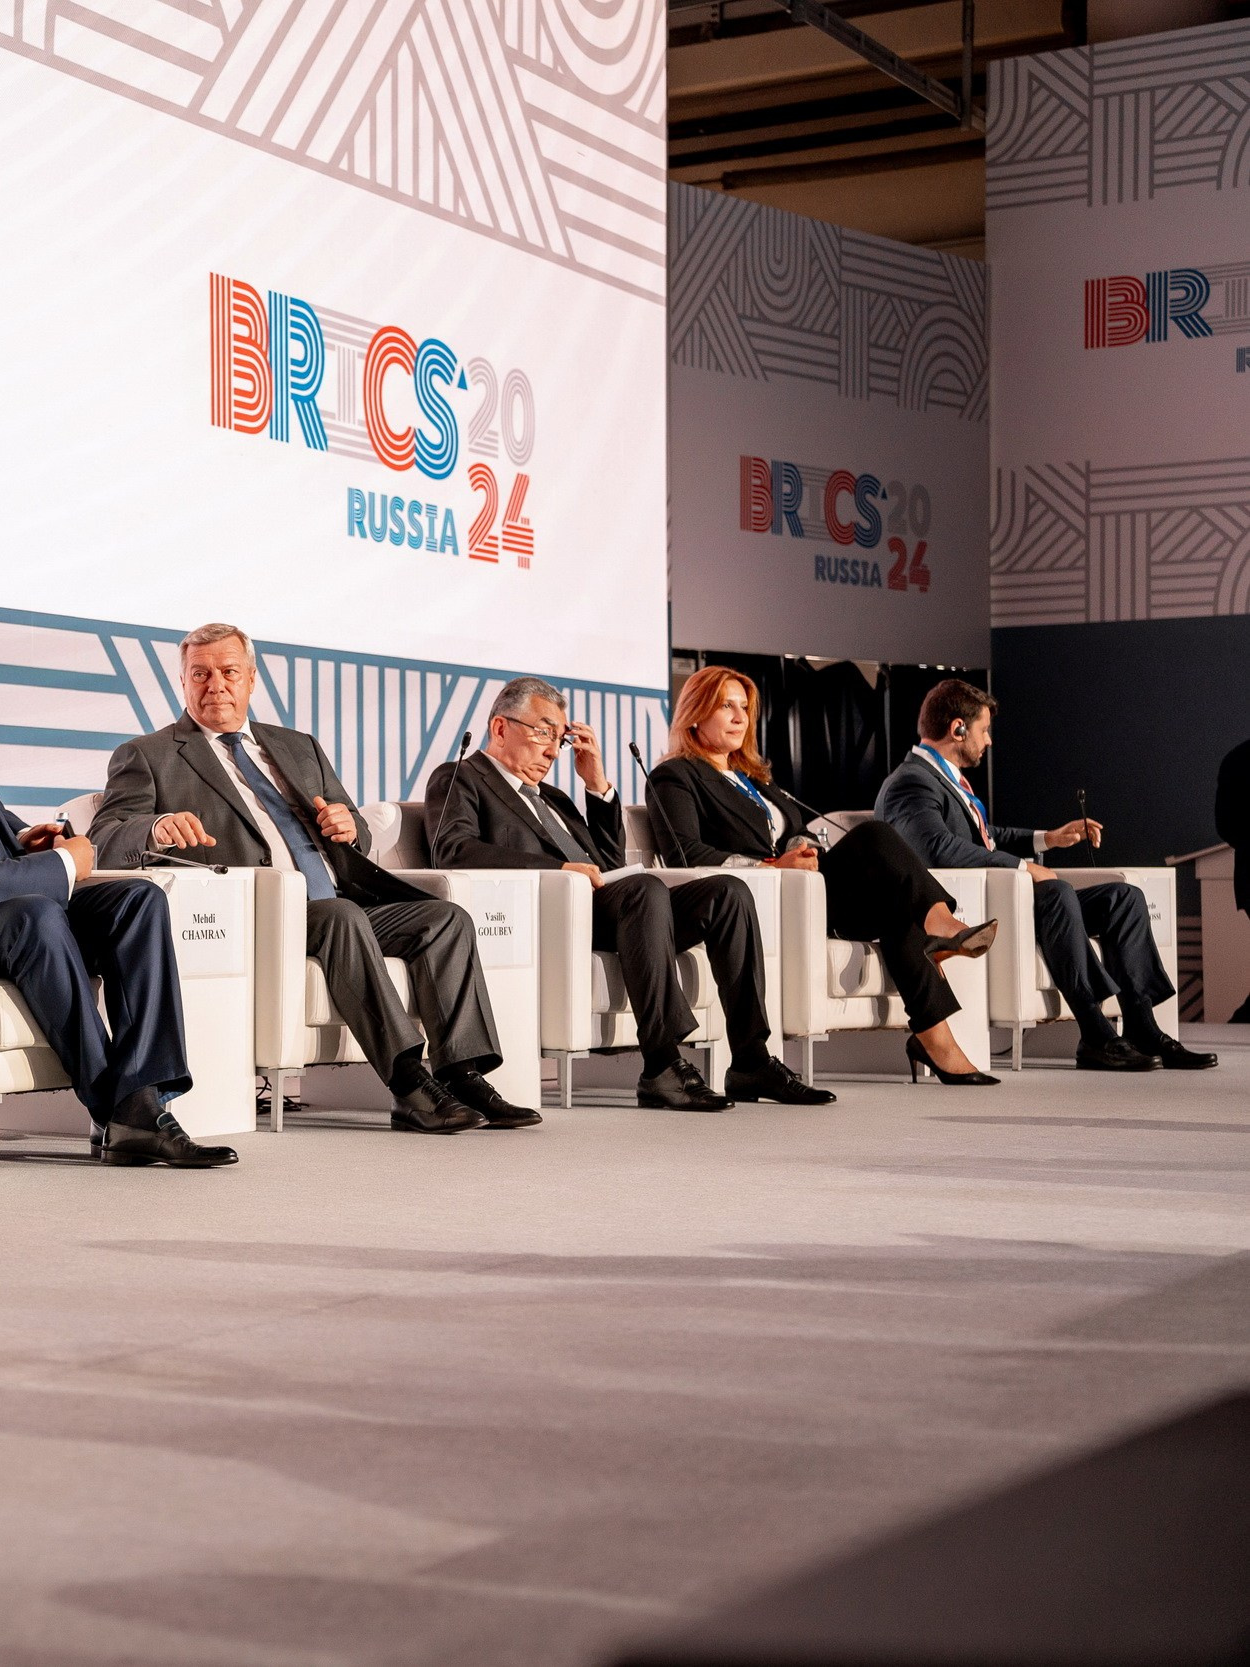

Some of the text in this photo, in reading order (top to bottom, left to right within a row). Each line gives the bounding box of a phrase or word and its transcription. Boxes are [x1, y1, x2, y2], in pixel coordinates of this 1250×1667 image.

[209, 271, 536, 480] BRICS 20
[347, 462, 535, 569] RUSSIA 24
[740, 455, 932, 548] BRICS 20
[814, 535, 931, 593] RUSSIA 24
[181, 929, 226, 940] CHAMRAN
[192, 913, 216, 924] Mehdi
[478, 926, 513, 936] GOLUBEV
[485, 912, 507, 923] Vasiliy
